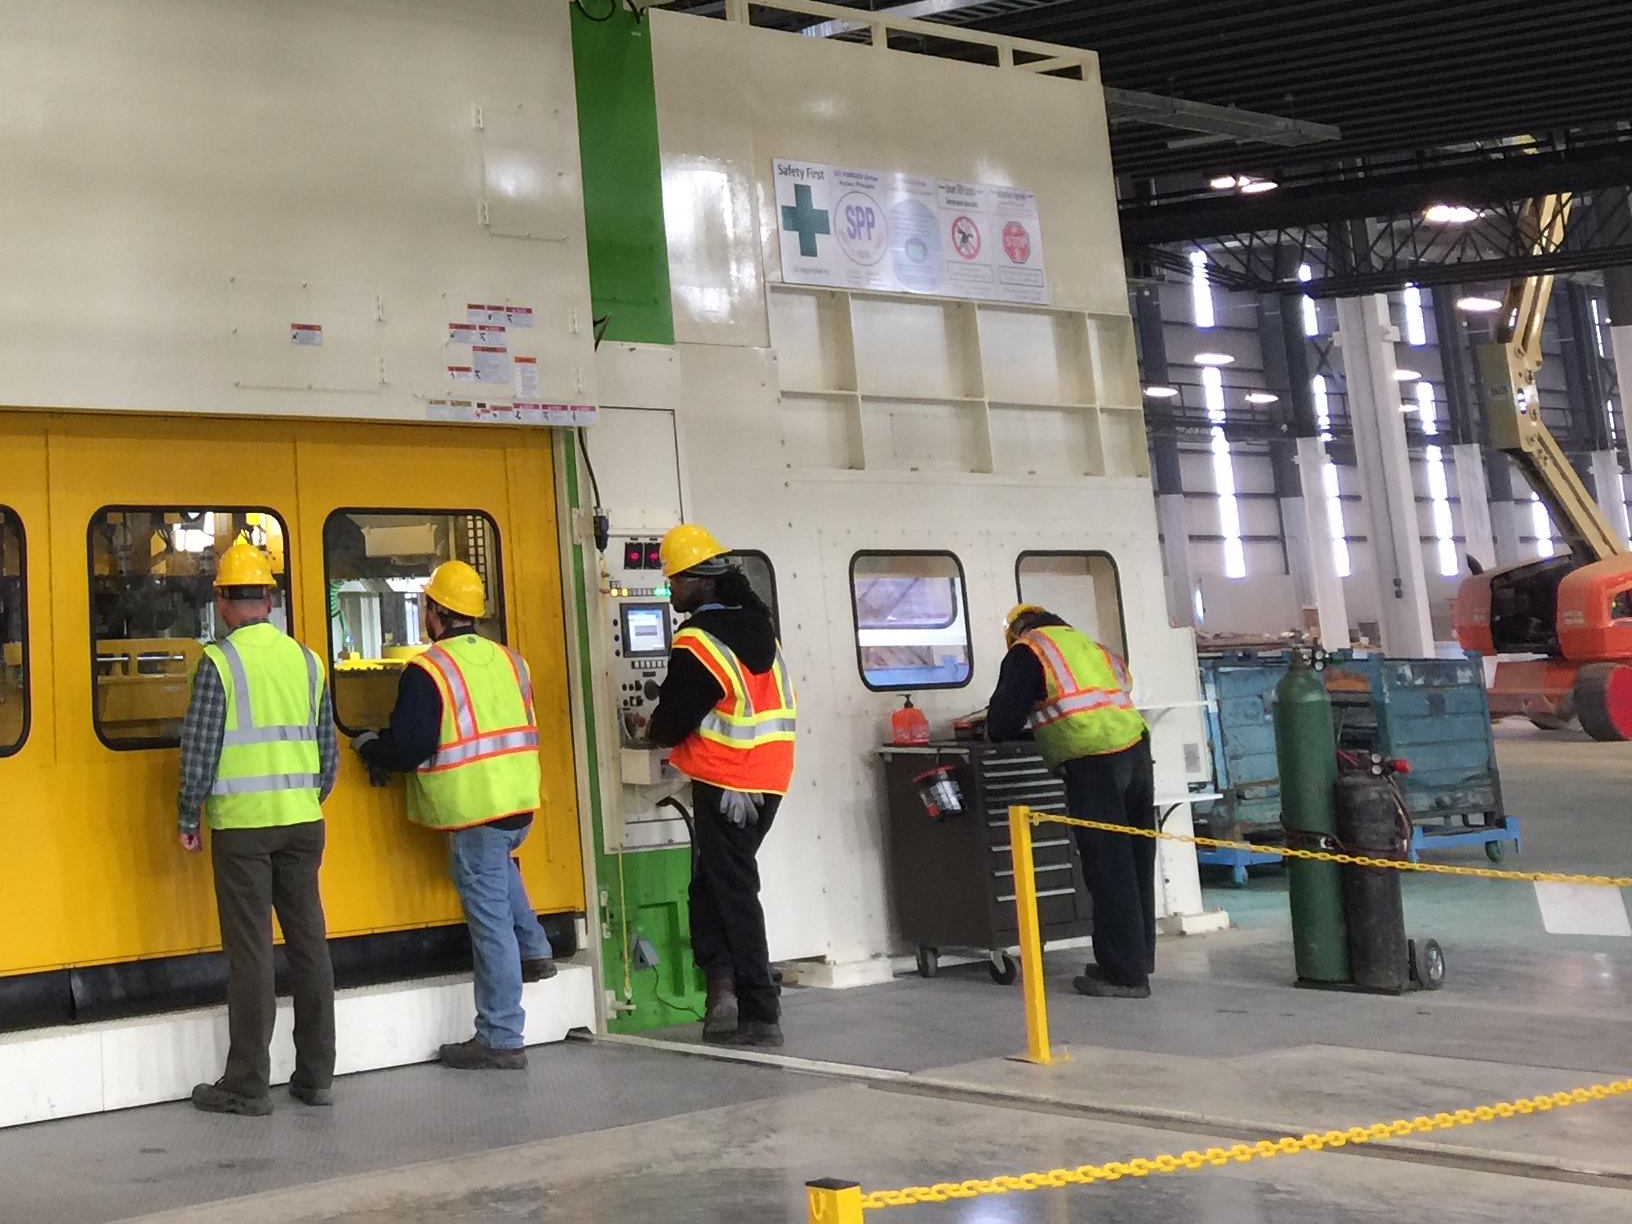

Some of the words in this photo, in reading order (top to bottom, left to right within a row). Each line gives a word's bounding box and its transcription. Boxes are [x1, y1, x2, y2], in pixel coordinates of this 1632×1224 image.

[777, 164, 805, 180] Safety
[806, 168, 825, 180] First
[845, 205, 876, 241] SPP
